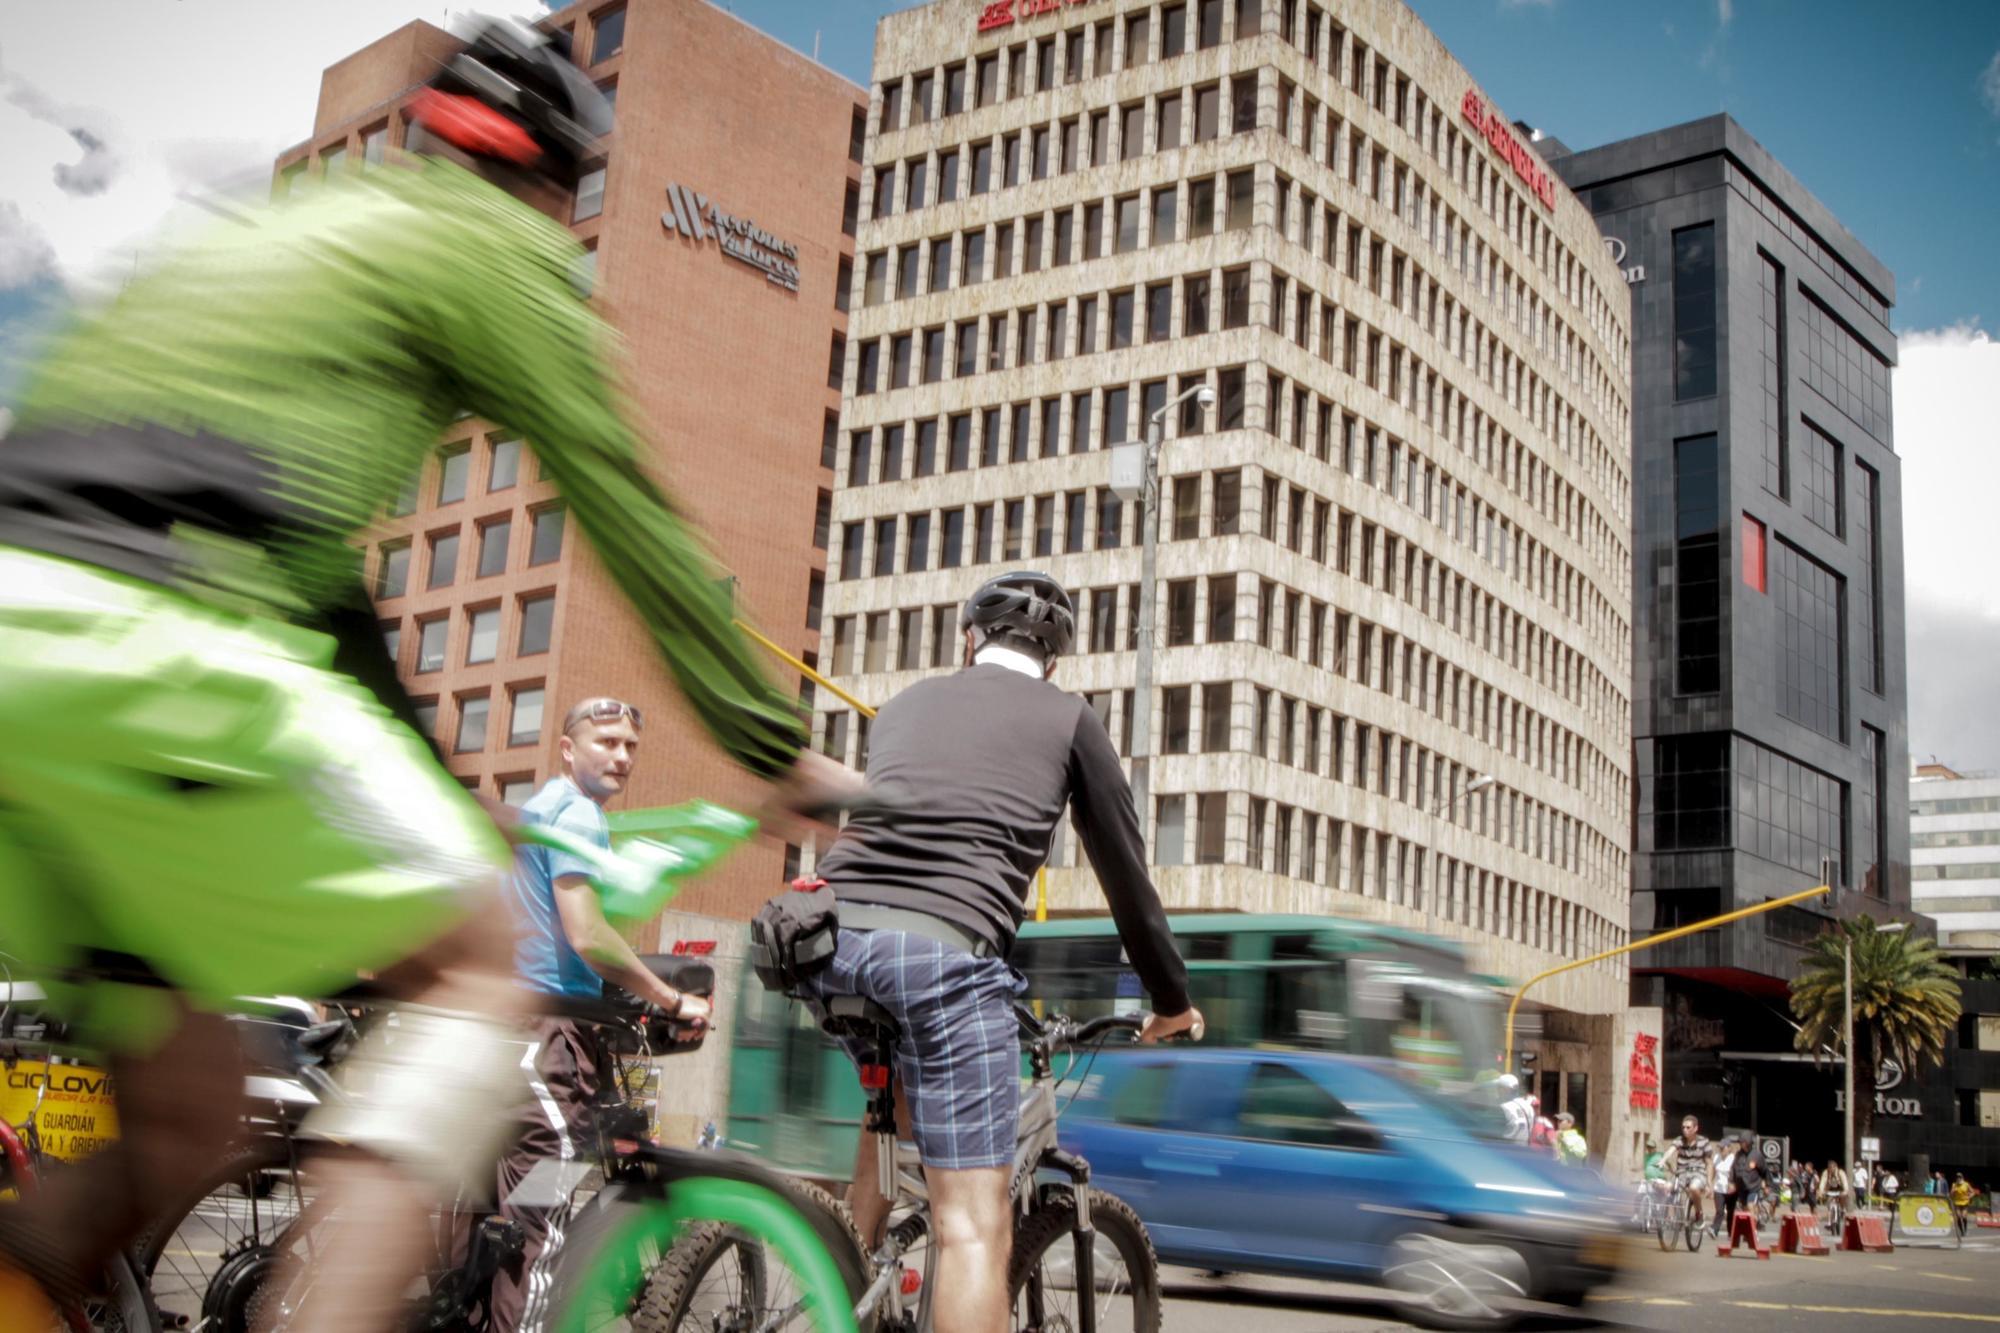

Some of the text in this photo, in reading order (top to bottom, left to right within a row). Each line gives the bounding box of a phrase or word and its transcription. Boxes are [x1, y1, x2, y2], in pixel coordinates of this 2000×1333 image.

[716, 226, 799, 281] Valores
[43, 1109, 95, 1132] GUARDIÁN
[70, 1135, 108, 1154] ORIENT
